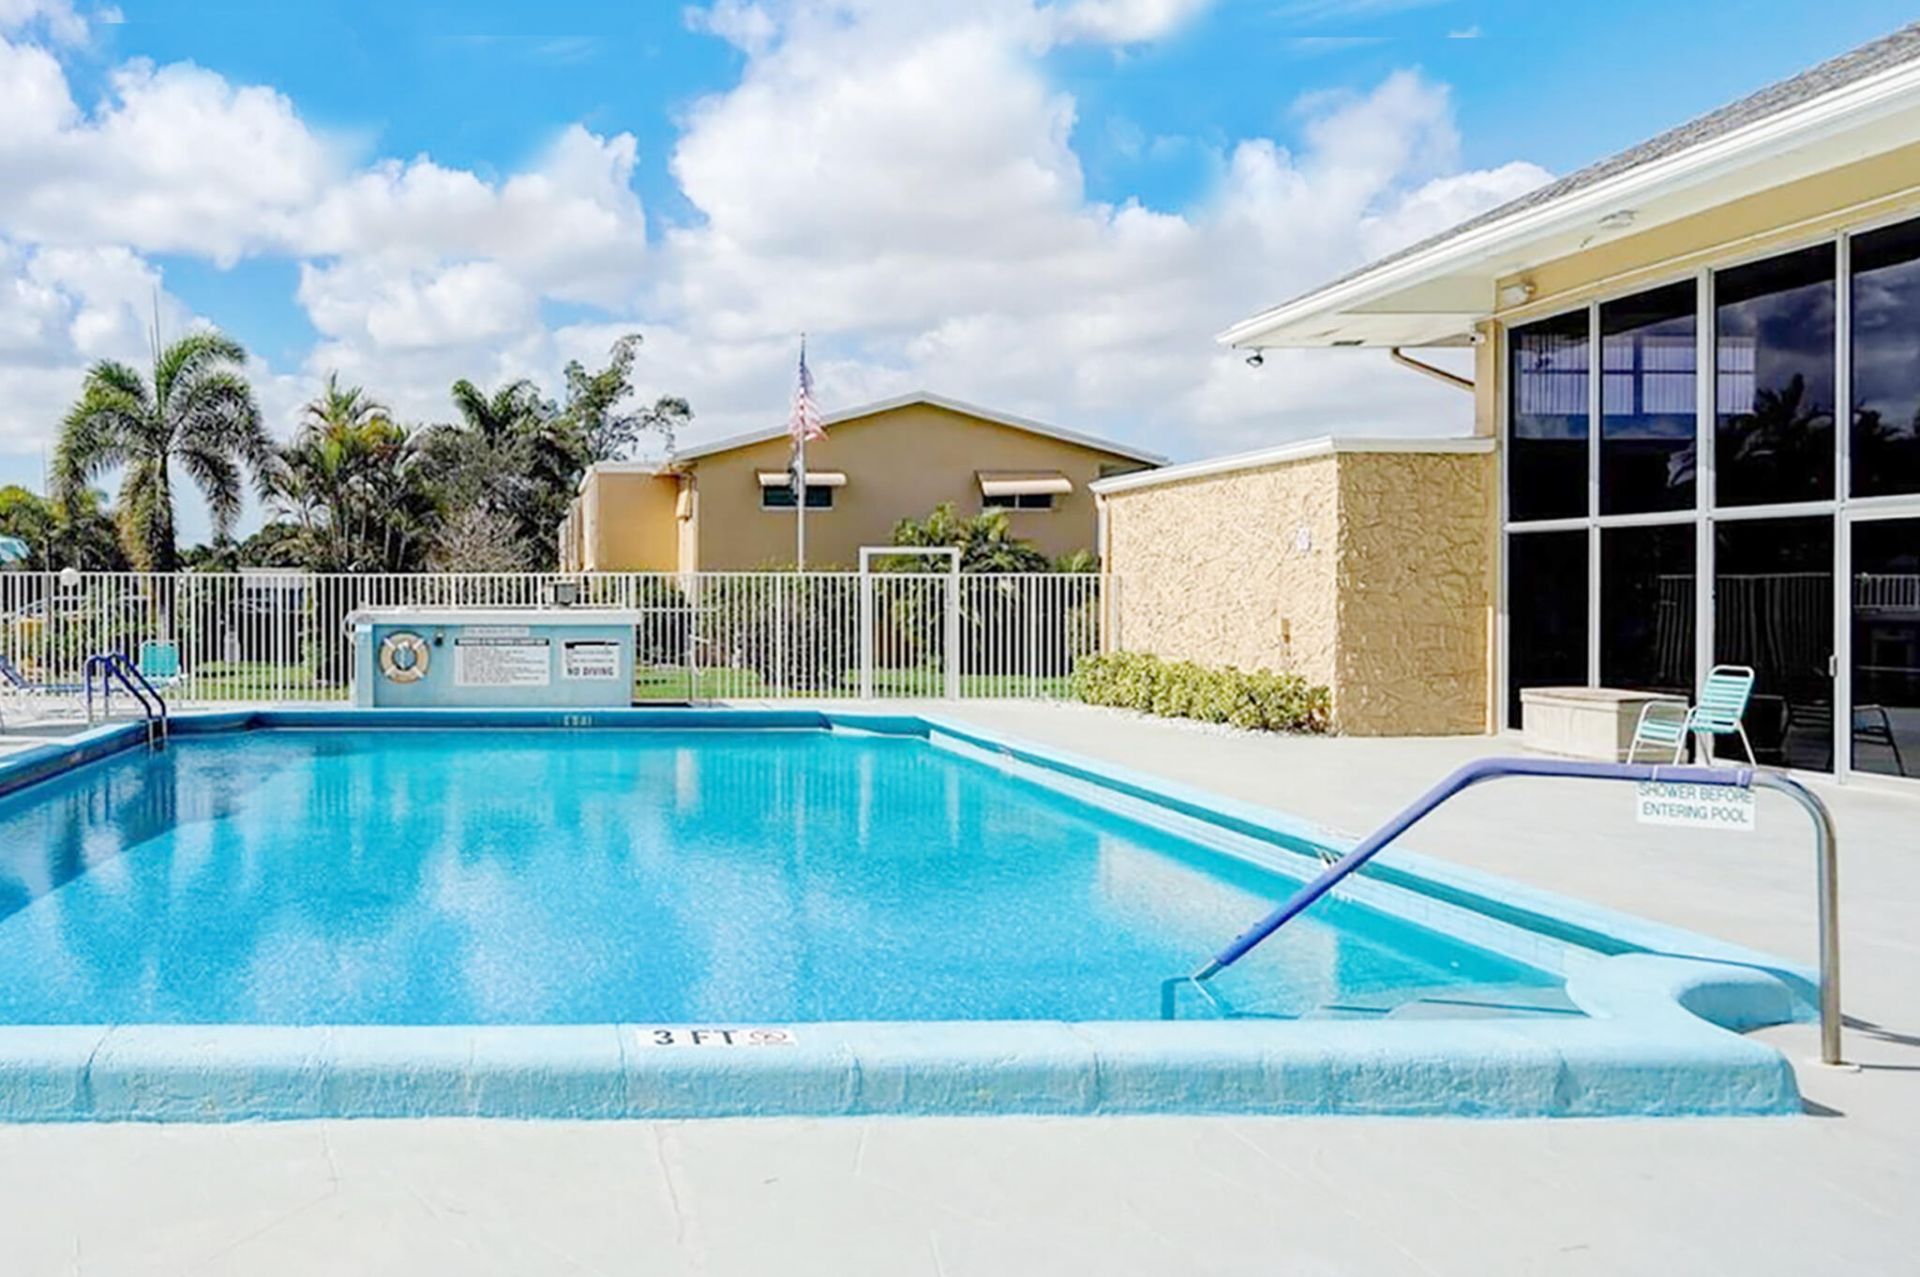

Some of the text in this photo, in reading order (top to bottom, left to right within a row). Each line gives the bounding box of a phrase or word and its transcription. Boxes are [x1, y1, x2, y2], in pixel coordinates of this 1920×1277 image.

[567, 666, 614, 676] NO DIVING
[1639, 782, 1755, 804] SHOWER BEFORE
[1643, 802, 1749, 822] ENTERING POOL
[653, 1029, 738, 1045] 3 FT
